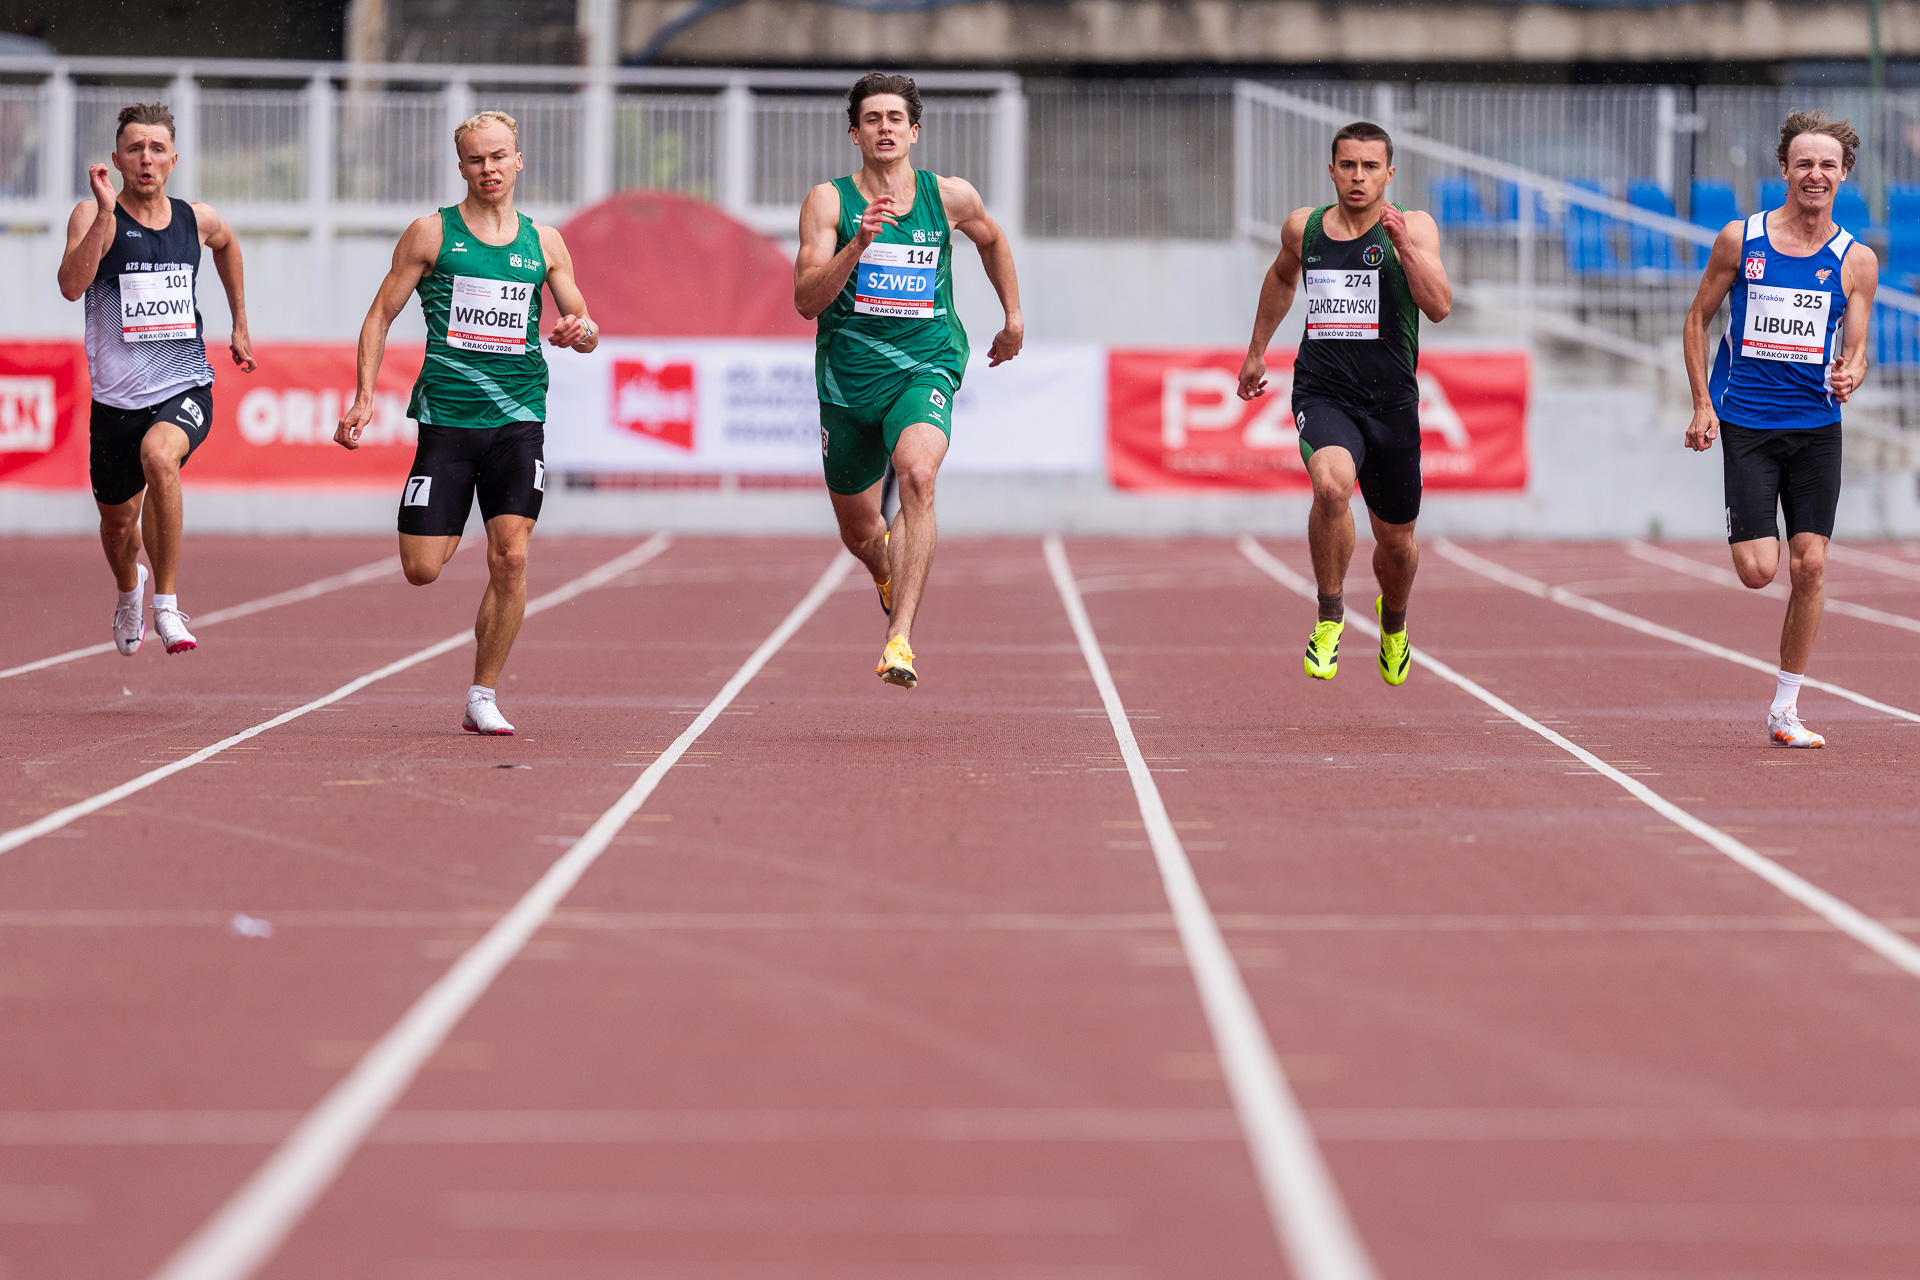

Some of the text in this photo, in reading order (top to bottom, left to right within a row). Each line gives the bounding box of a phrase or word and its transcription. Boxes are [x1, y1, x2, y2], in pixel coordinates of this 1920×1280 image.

[907, 249, 934, 264] 114
[125, 262, 139, 271] AZS
[165, 275, 187, 288] 101
[867, 272, 927, 292] SZWED
[1314, 276, 1336, 284] Kraków
[1344, 274, 1371, 288] 274
[500, 285, 526, 301] 116
[1758, 293, 1785, 302] Kraków
[125, 299, 191, 318] ŁAZOWY
[1309, 299, 1376, 314] ZAKRZEWSKI
[1793, 293, 1823, 309] 325
[455, 306, 524, 329] WRÓBEL
[869, 306, 903, 315] KRAKÓW
[1754, 315, 1816, 337] LIBURA
[138, 332, 170, 340] KRAKÓW
[462, 341, 495, 351] KRAKÓW
[1756, 350, 1808, 361] KRAKÓW 2026
[1162, 367, 1471, 450] PZA
[411, 479, 425, 503] 7
